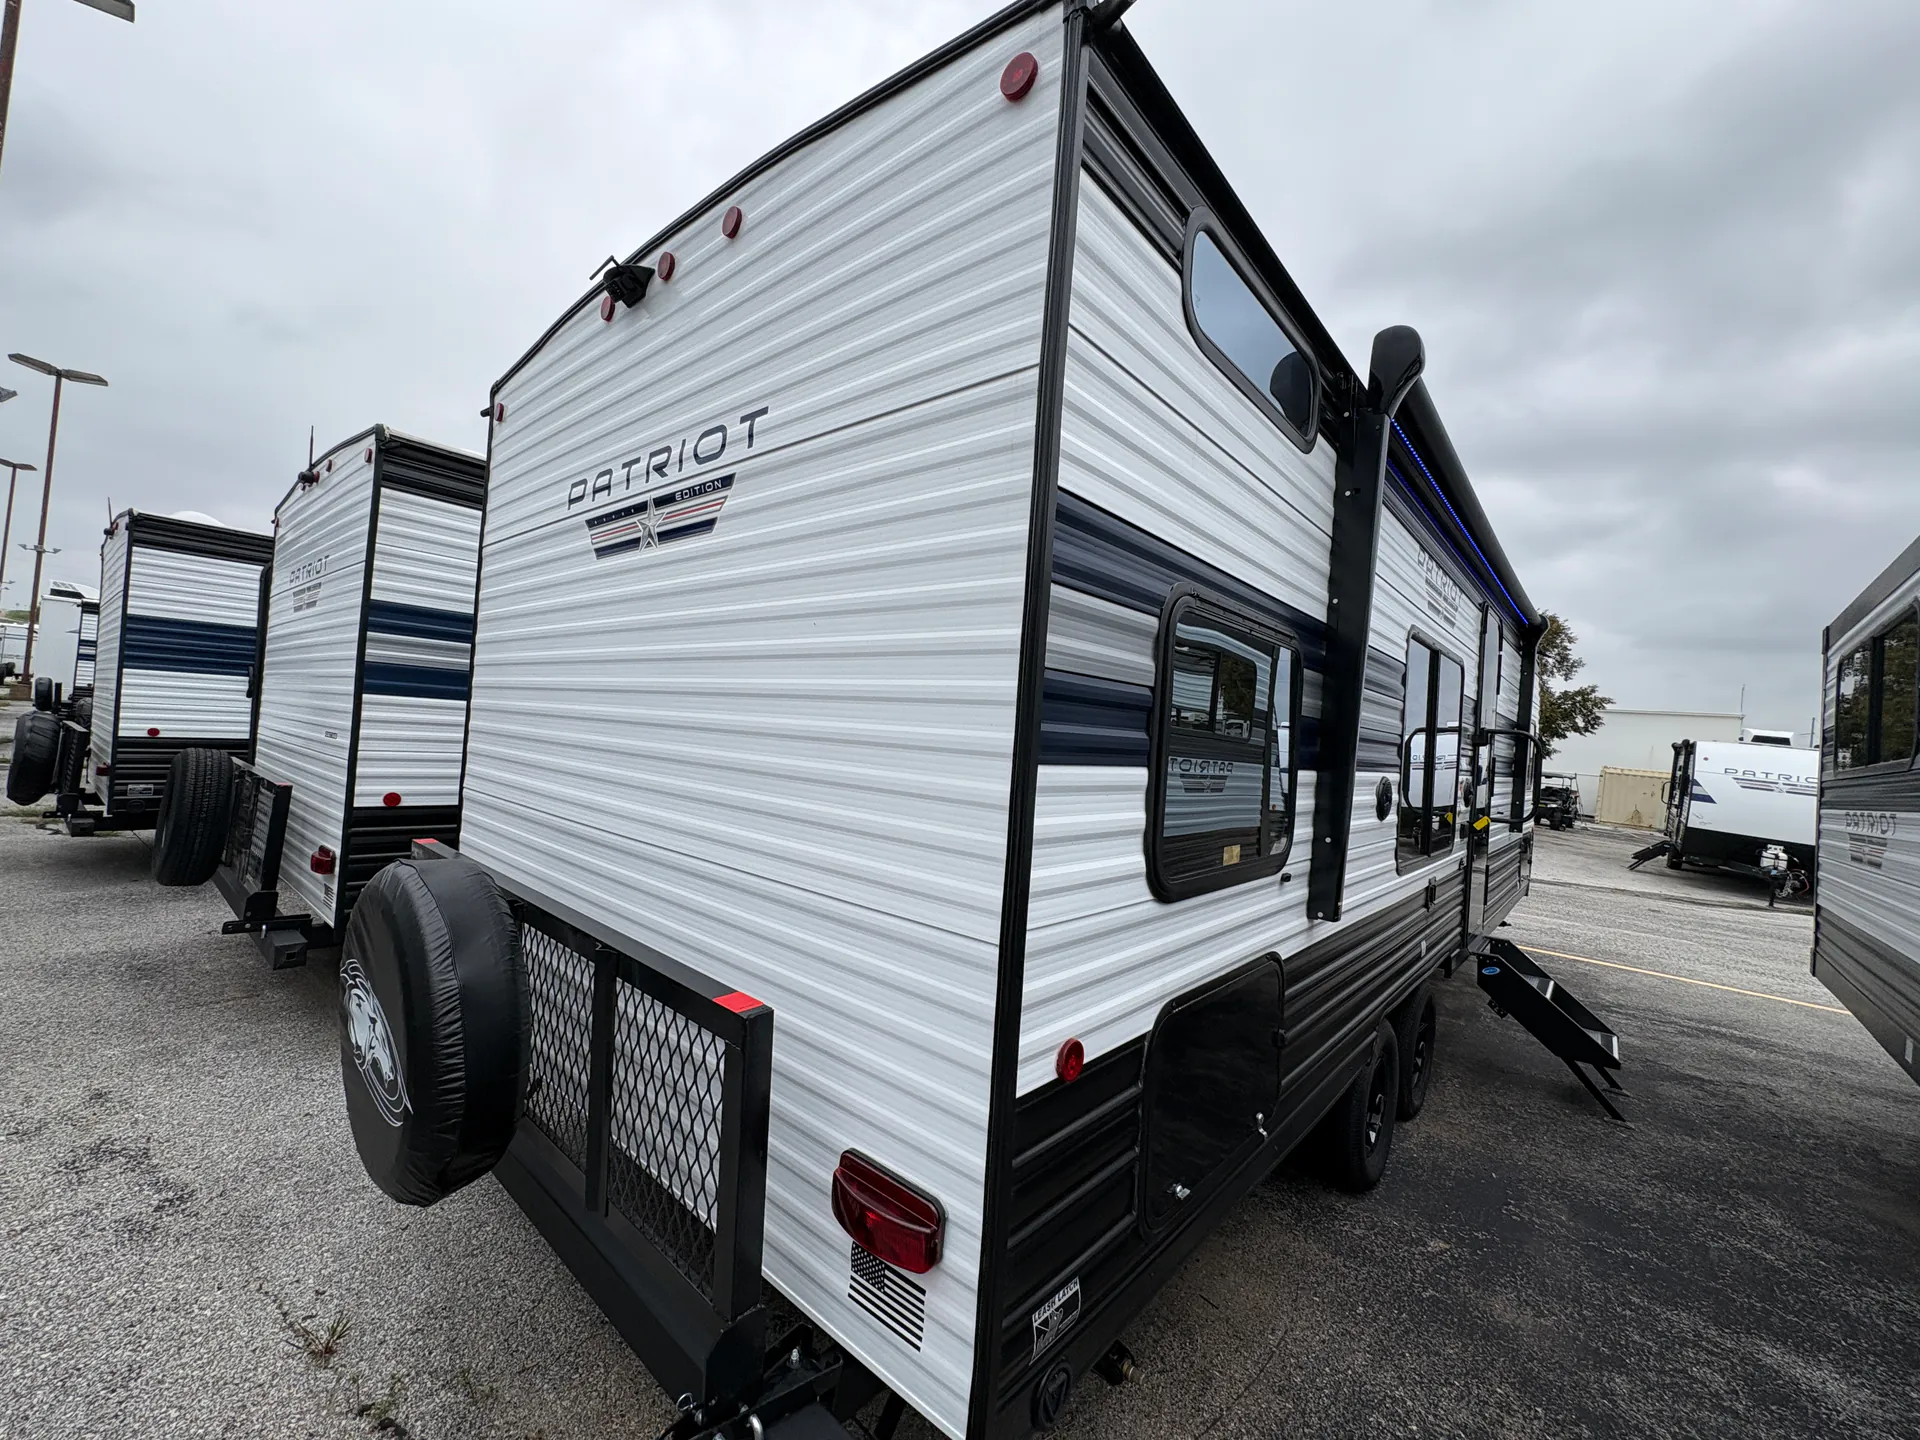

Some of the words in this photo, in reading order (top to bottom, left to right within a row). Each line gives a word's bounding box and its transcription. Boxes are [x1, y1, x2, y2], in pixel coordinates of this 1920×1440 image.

[567, 405, 770, 510] PATRIOT
[675, 479, 722, 501] EDITION
[289, 554, 330, 585] PATRIOT
[1724, 767, 1818, 784] PATRIO
[1845, 811, 1897, 836] PATRIOT
[1033, 1299, 1056, 1322] LEASH
[1057, 1279, 1078, 1302] LATCH
